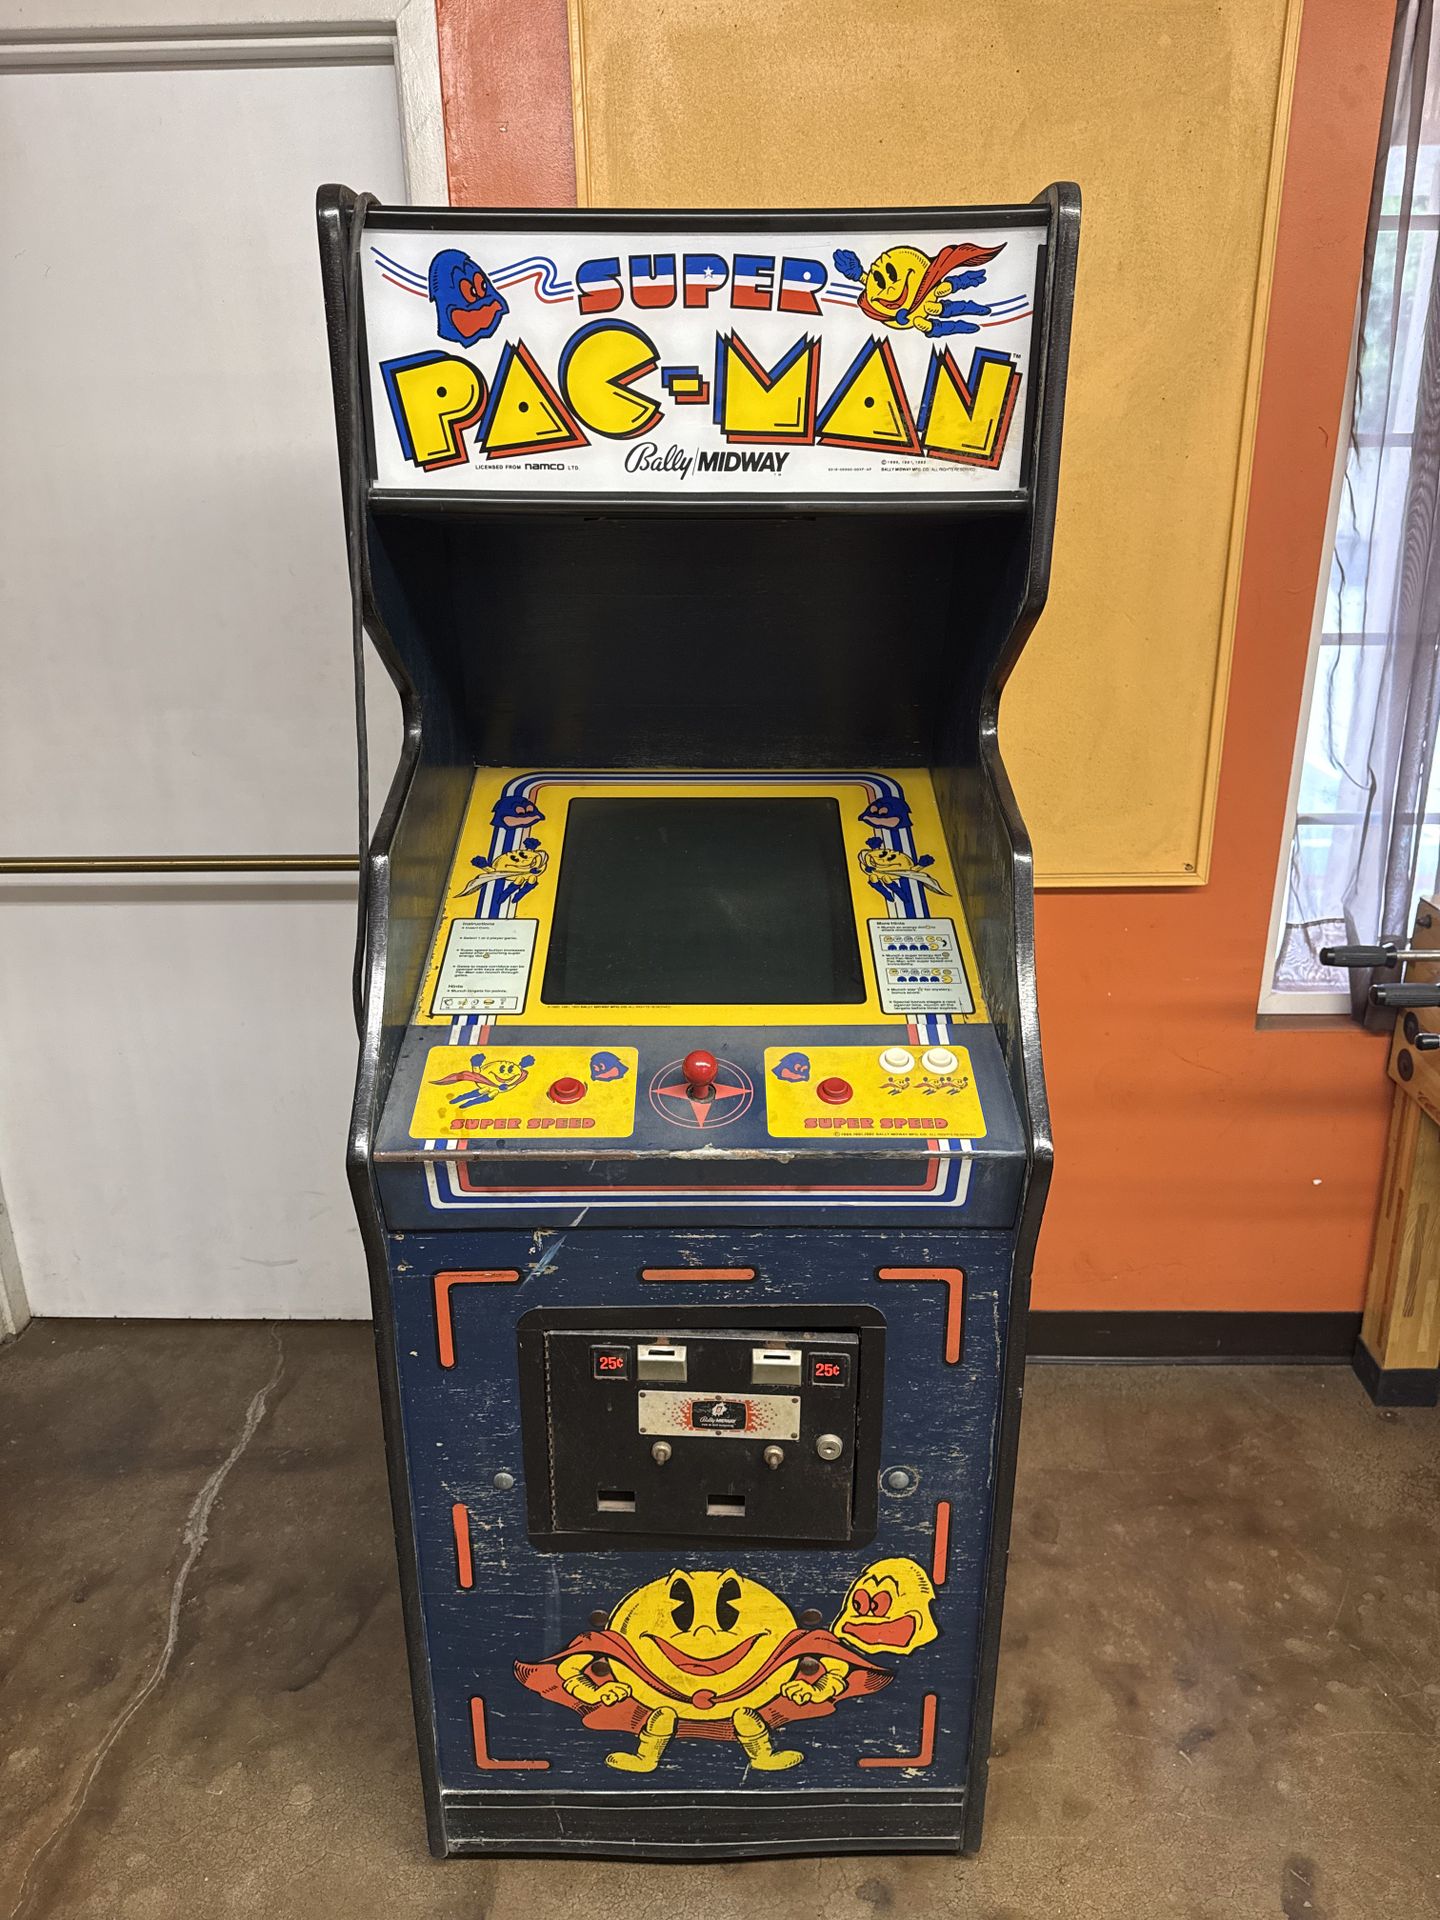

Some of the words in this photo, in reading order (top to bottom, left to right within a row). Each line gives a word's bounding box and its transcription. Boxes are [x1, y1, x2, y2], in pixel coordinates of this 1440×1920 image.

[578, 253, 828, 315] SUPER
[378, 318, 1022, 471] PAC-MAN
[524, 462, 564, 471] namco
[624, 442, 694, 480] Bally
[697, 451, 790, 472] MIDWAY
[450, 1118, 522, 1129] SUPER
[526, 1117, 596, 1129] SPEED
[804, 1117, 874, 1129] SUPER
[879, 1117, 949, 1129] SPEED
